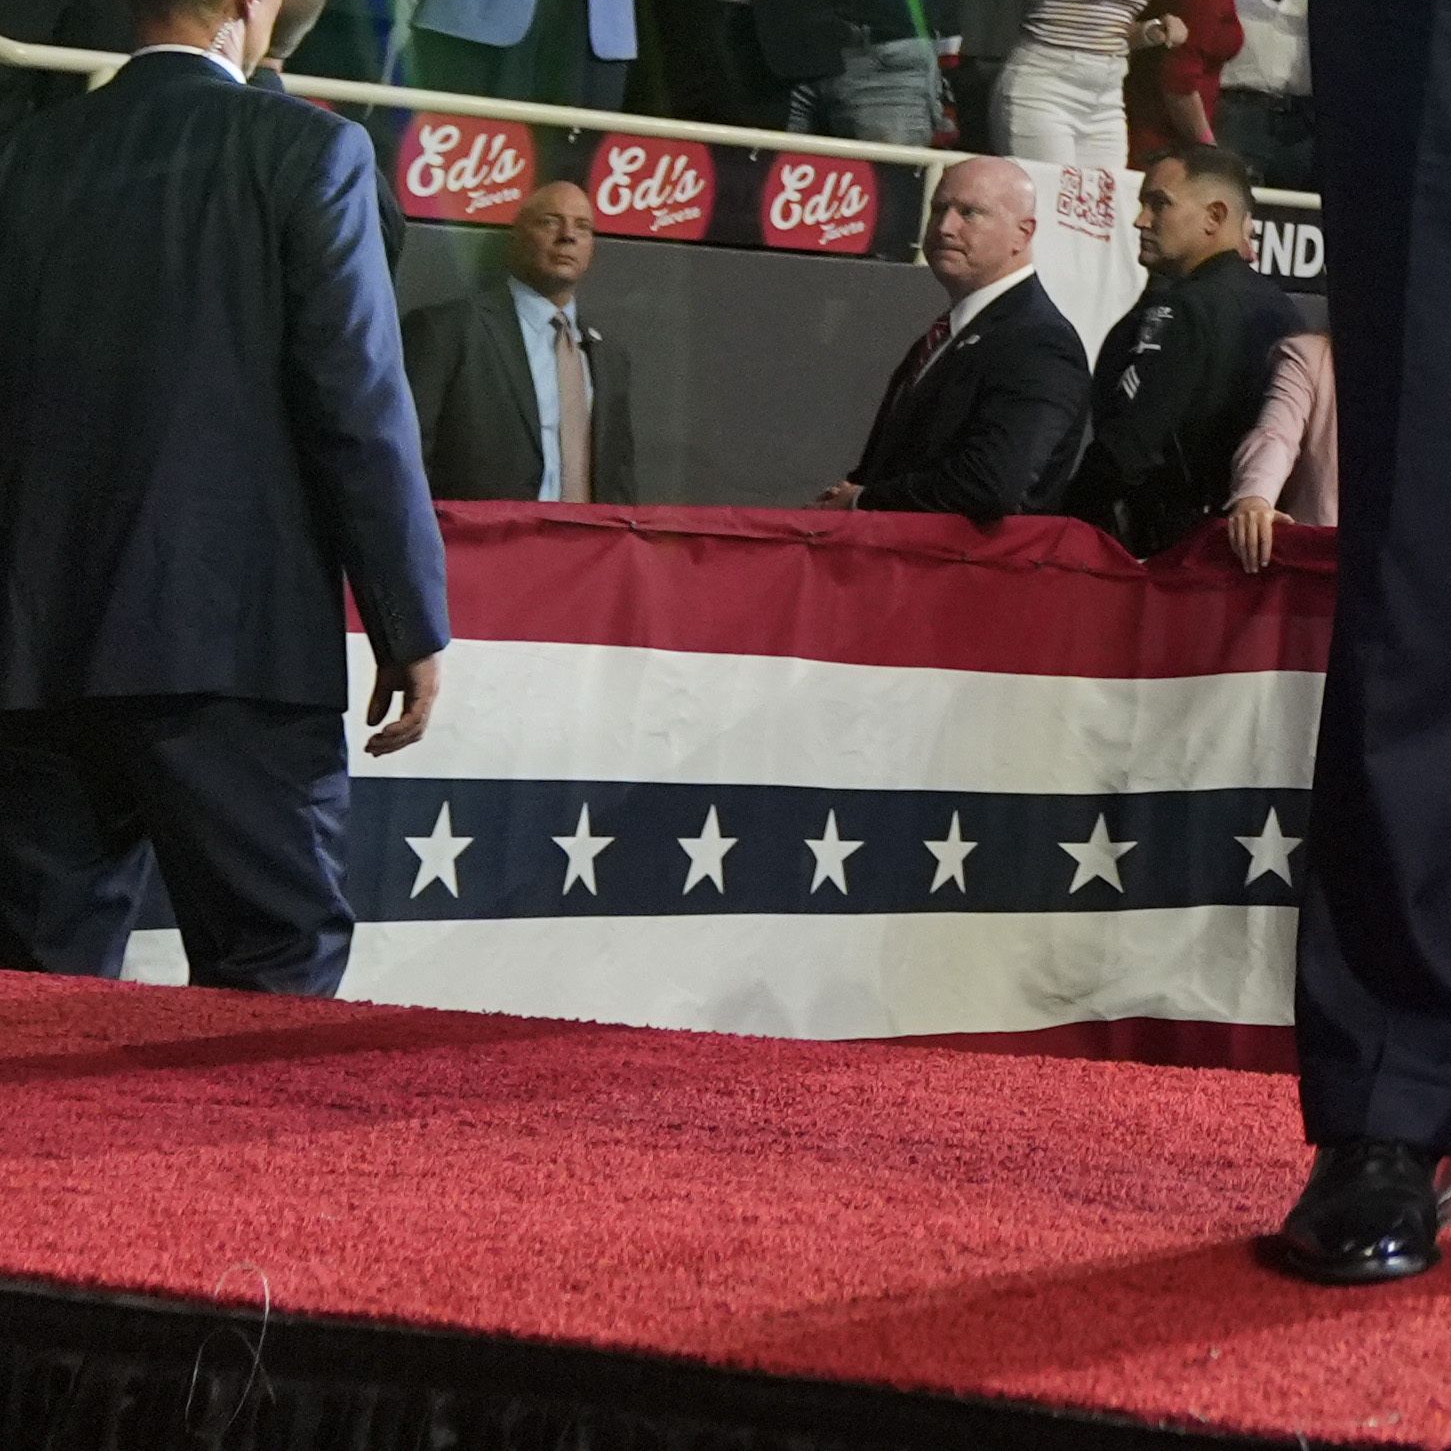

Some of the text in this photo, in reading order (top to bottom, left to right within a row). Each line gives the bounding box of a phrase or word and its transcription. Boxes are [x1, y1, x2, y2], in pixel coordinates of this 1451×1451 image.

[405, 123, 527, 198] Ed's
[596, 145, 705, 216] Ed's
[769, 164, 870, 231] Ed's
